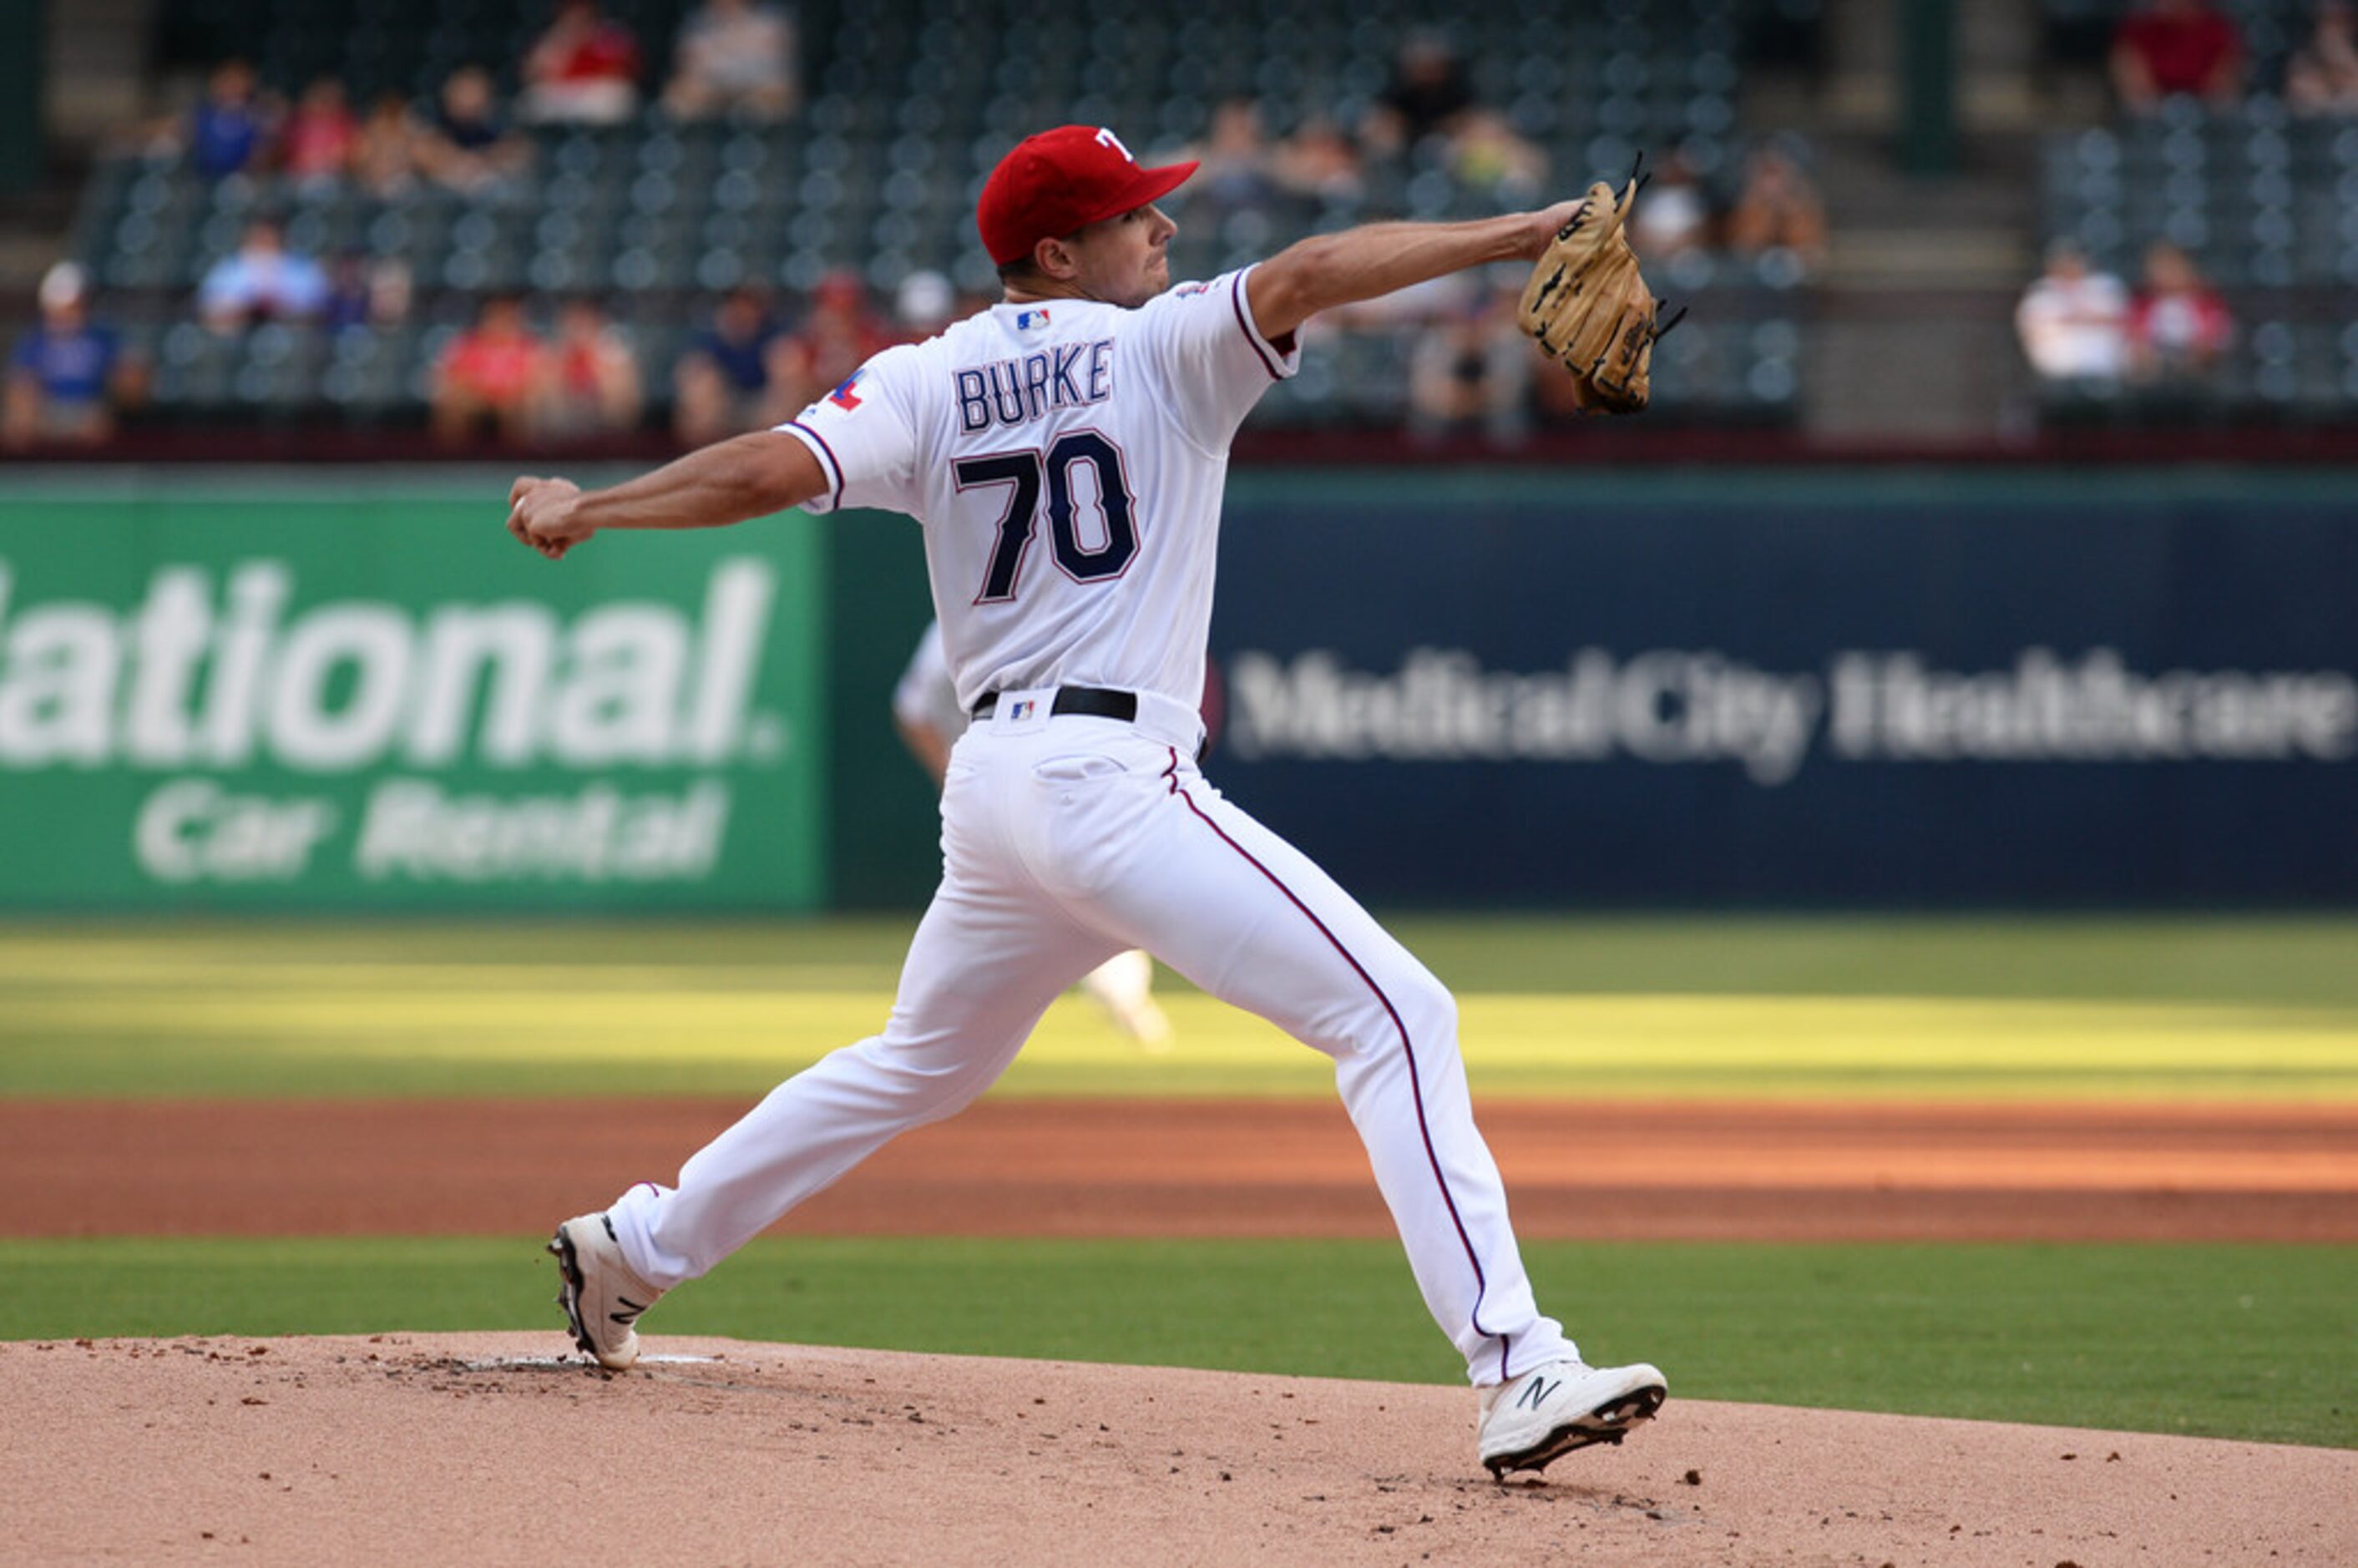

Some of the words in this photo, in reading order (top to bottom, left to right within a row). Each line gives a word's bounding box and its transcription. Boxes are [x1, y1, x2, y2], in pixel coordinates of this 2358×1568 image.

[1095, 127, 1134, 164] T
[953, 337, 1115, 436] BURKE
[950, 427, 1141, 605] 70
[0, 558, 775, 770] ational
[1231, 648, 1613, 760] Medical
[1617, 650, 1824, 785] City
[1830, 647, 2356, 761] Healthcare
[136, 780, 334, 881] Car
[359, 778, 726, 881] Rental
[1517, 1376, 1561, 1411] N
